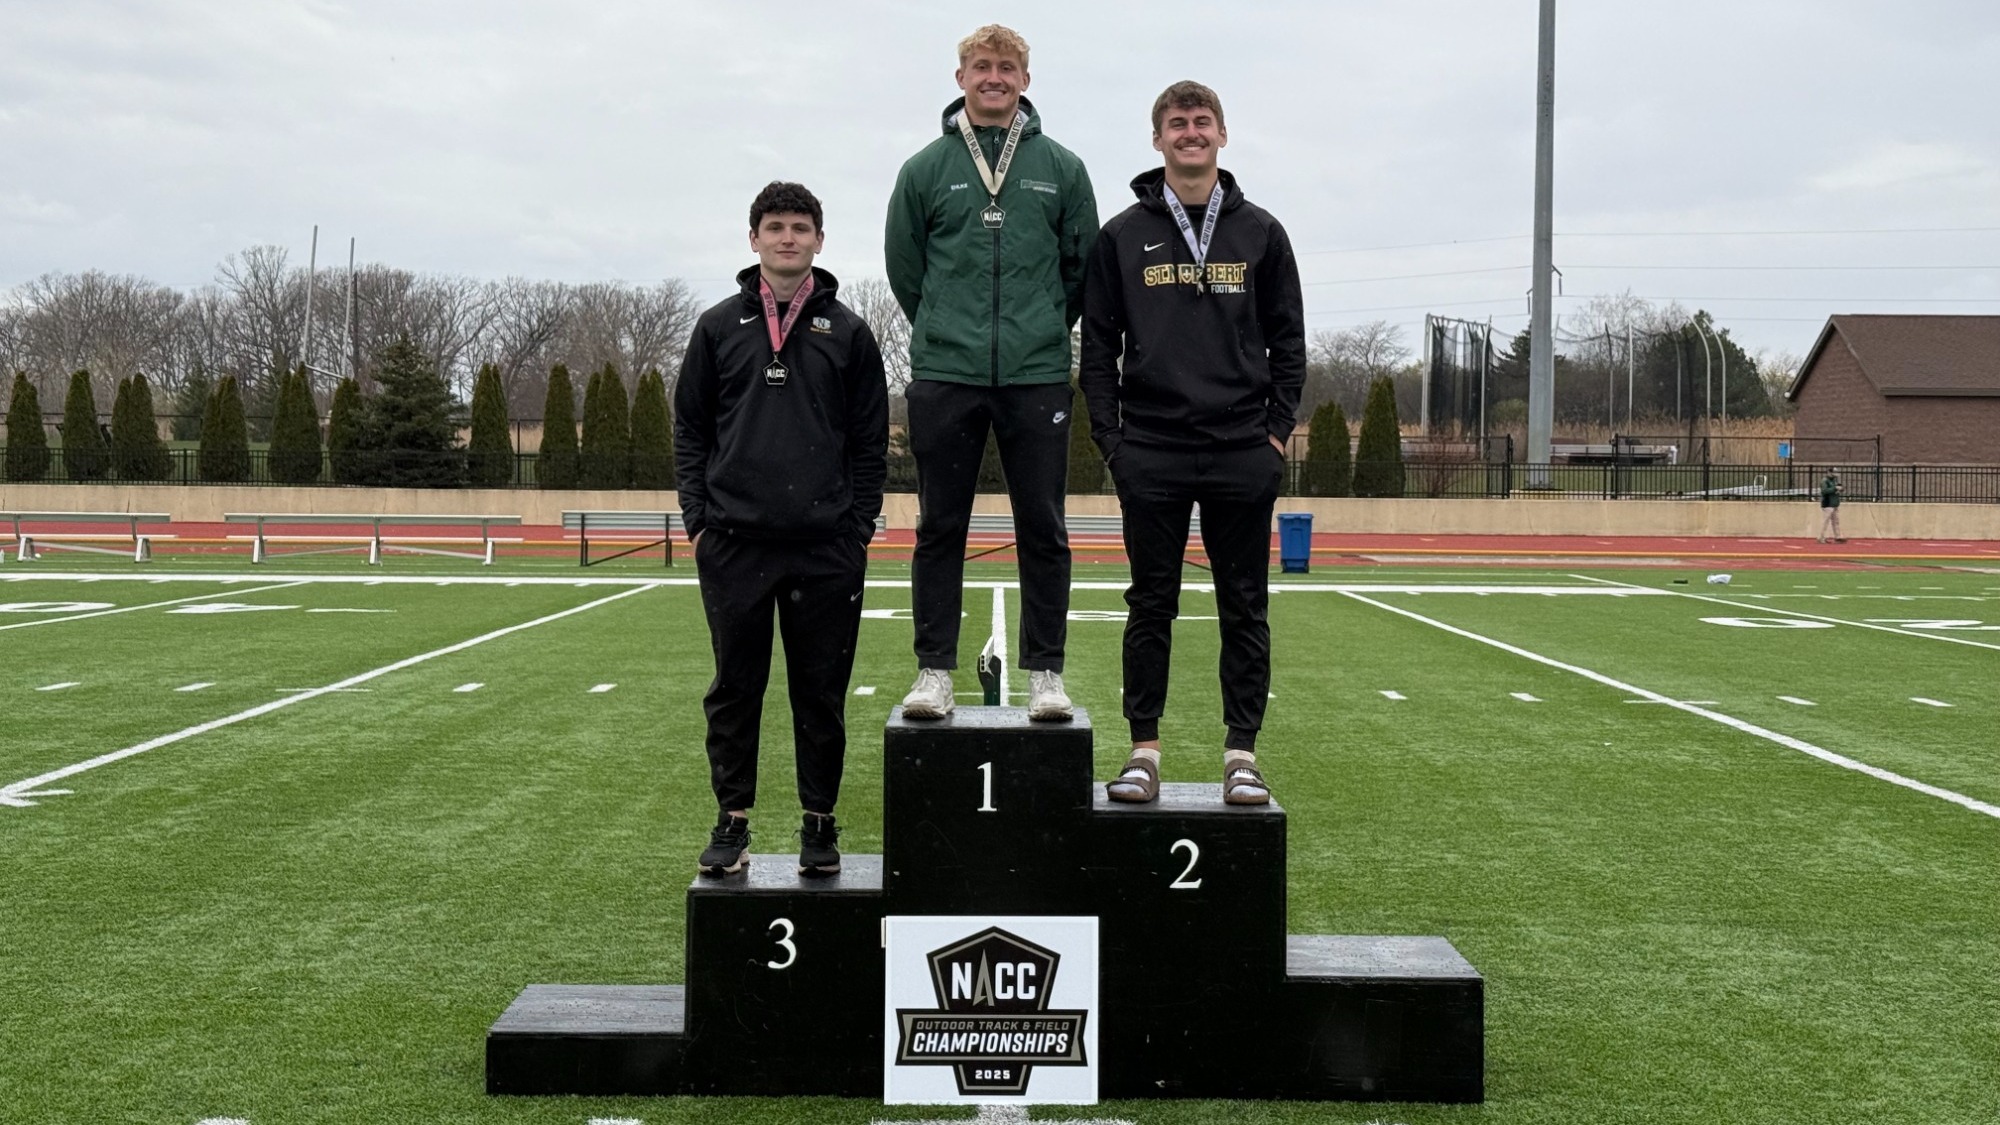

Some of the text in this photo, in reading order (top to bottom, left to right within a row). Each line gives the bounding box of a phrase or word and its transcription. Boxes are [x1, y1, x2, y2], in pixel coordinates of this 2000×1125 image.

[970, 141, 982, 160] PLACE
[1177, 212, 1190, 232] PLACE
[1211, 284, 1246, 294] FOOTBALL
[976, 760, 998, 813] 1
[1168, 838, 1203, 889] 2
[767, 917, 797, 969] 3
[952, 949, 1036, 1007] NACC
[916, 1021, 1070, 1031] OUTDOOR TRACK & FIELD
[913, 1032, 1069, 1053] CHAMPIONSHIPS
[975, 1069, 1011, 1079] 2025
